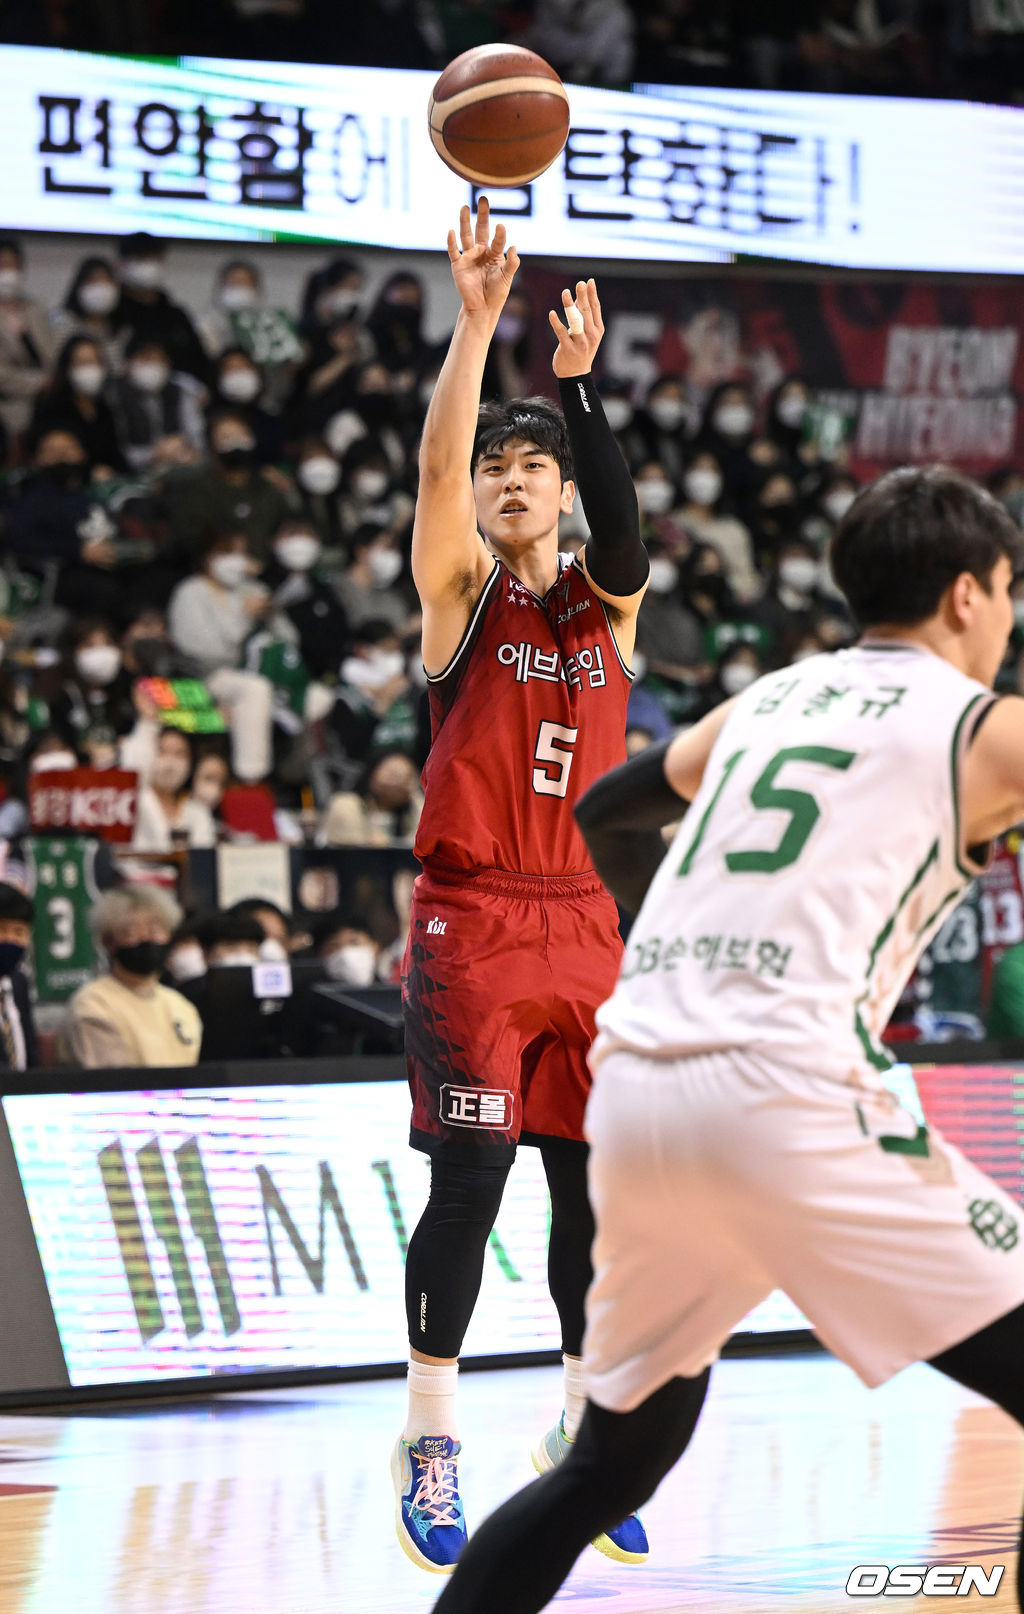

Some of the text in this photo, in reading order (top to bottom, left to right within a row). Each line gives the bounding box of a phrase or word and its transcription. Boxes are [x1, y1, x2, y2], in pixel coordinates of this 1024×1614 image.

[38, 94, 410, 212] 편안함에
[531, 719, 578, 798] 5
[676, 745, 858, 879] 15
[47, 896, 75, 960] 3
[448, 1090, 506, 1124] 正몰
